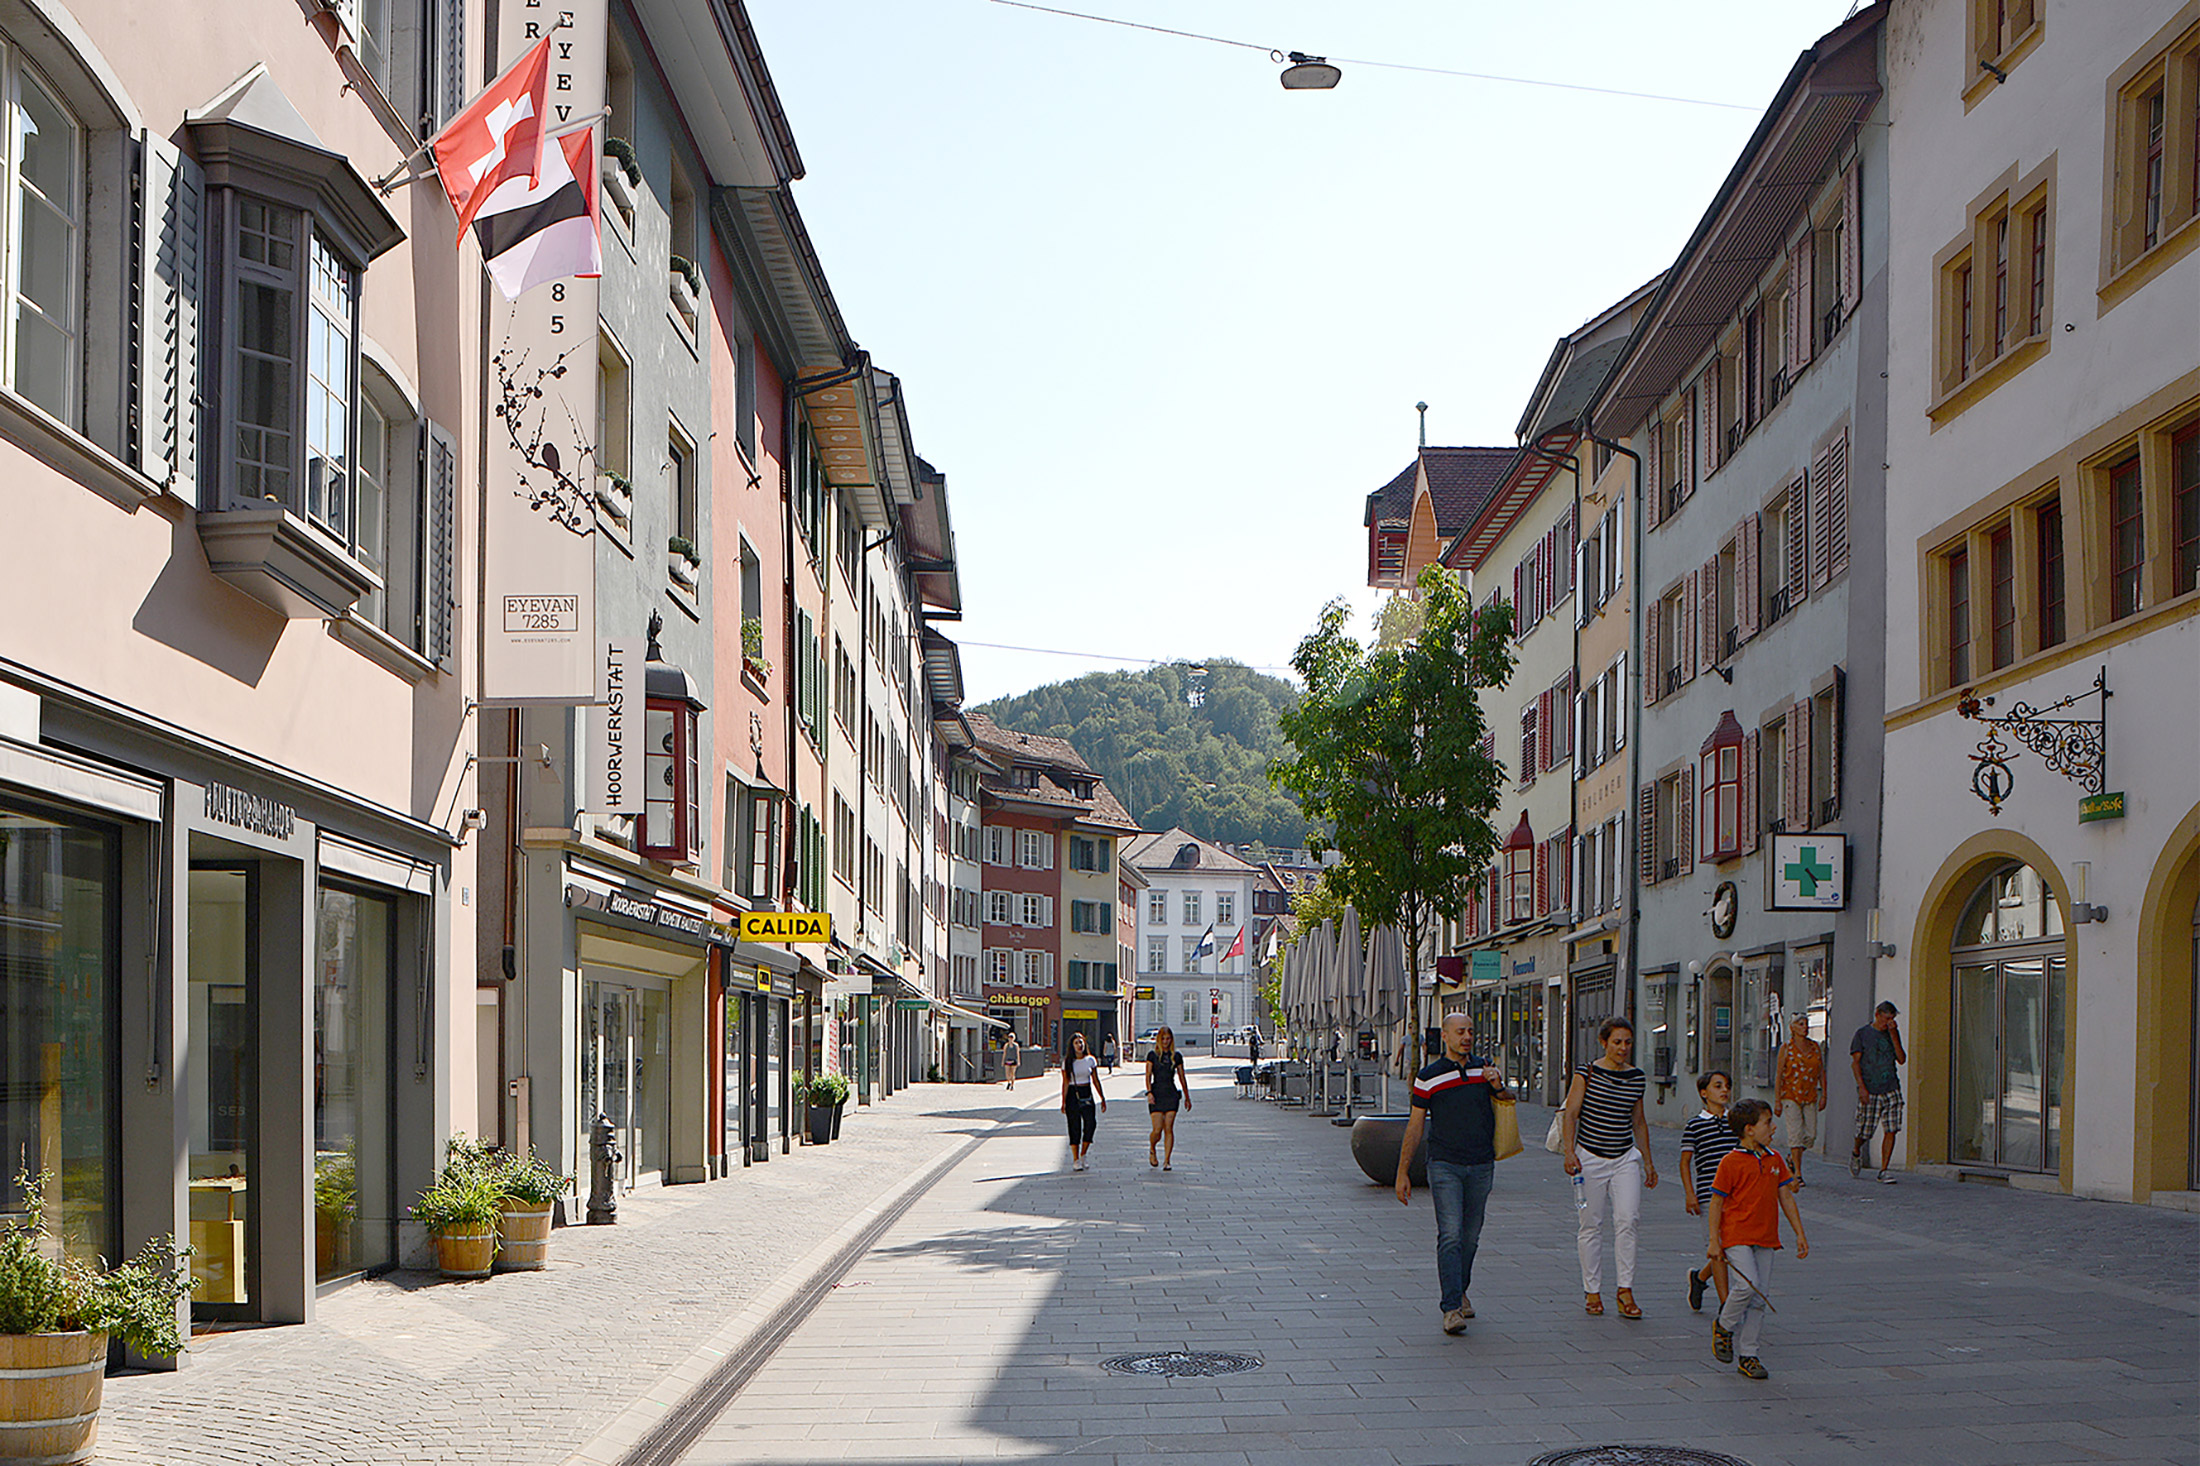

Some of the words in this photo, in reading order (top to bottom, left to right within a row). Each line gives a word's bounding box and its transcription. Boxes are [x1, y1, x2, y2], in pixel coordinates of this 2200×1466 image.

[507, 598, 574, 613] EYEVAN
[522, 613, 560, 629] 7285
[605, 642, 624, 807] HOORWERKSTATT
[747, 918, 823, 936] CALIDA
[989, 993, 1051, 1007] chäsegge
